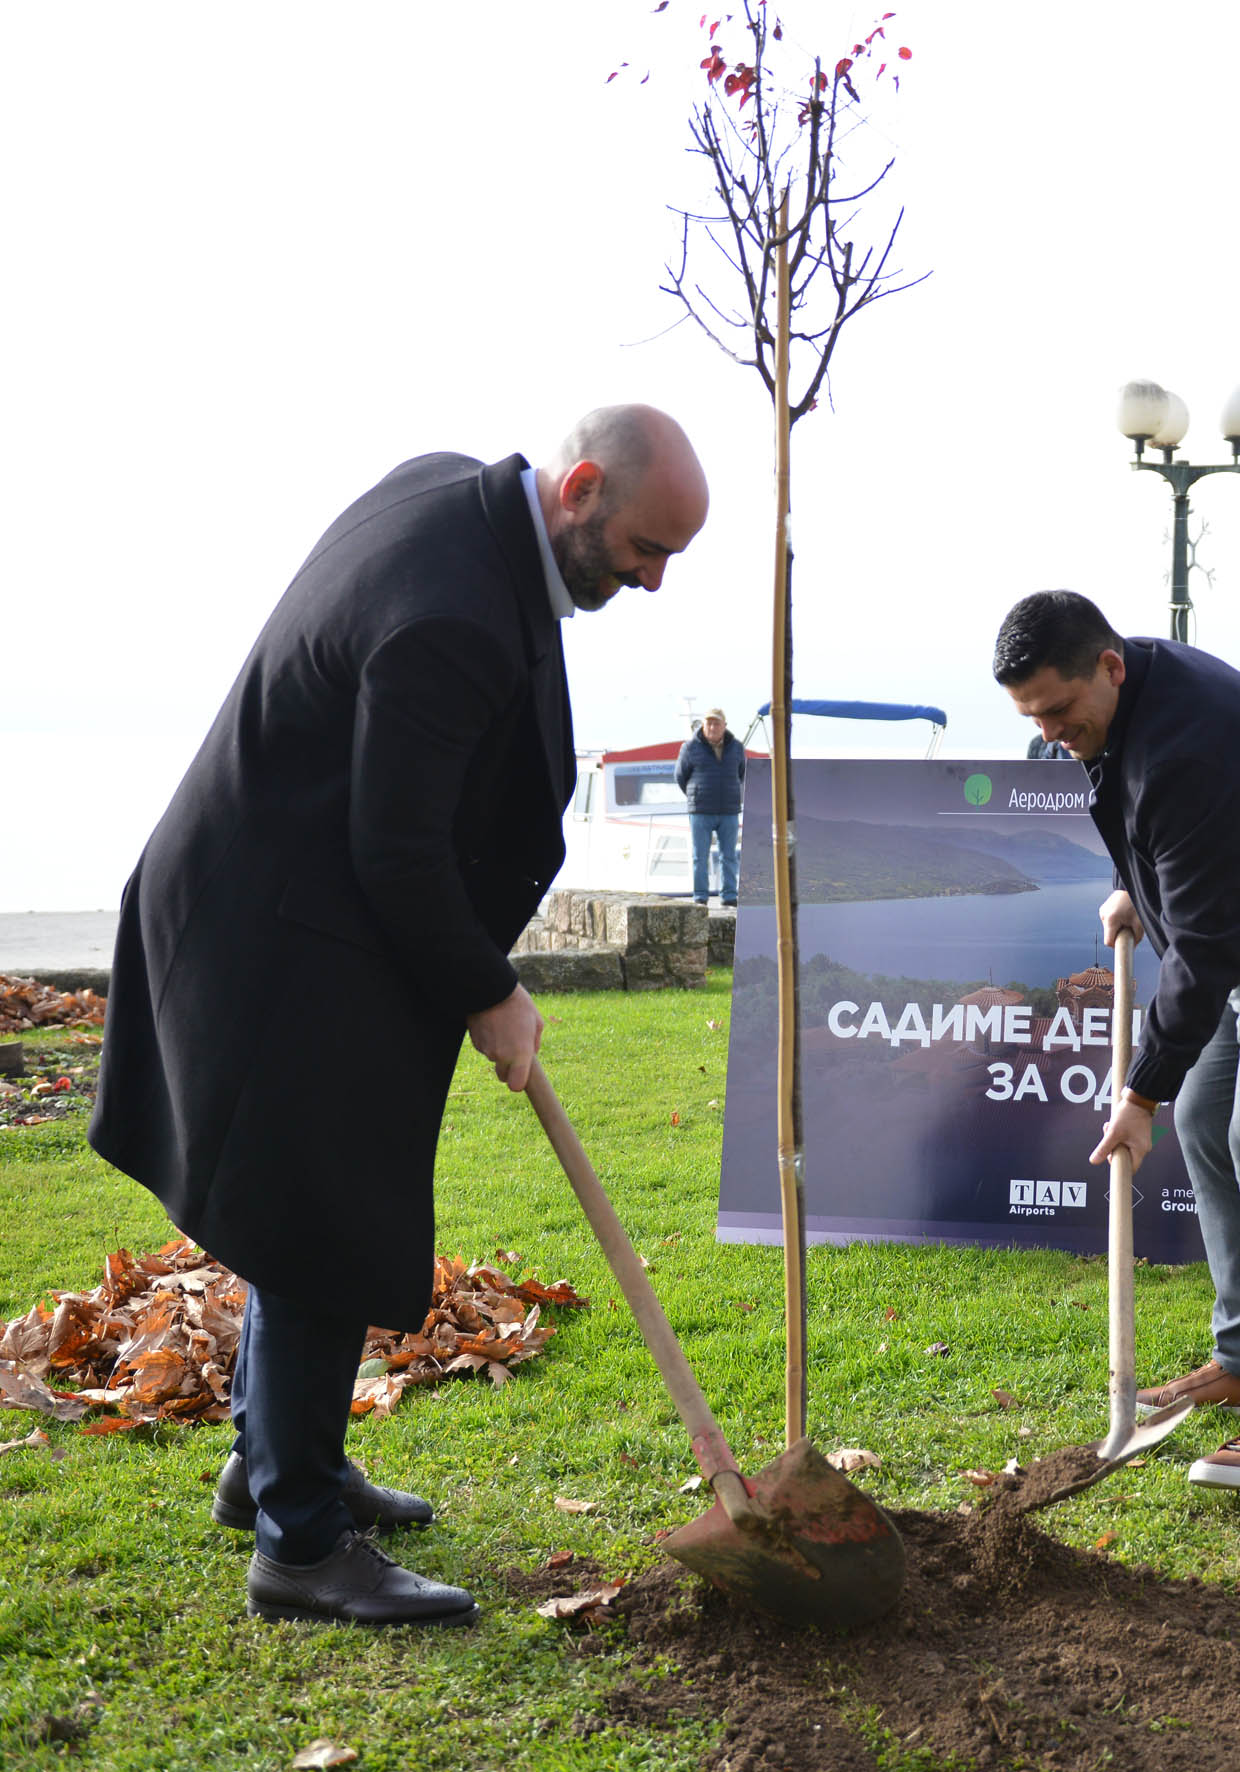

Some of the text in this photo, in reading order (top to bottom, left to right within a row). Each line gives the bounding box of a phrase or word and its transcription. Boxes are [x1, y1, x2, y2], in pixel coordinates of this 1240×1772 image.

[1008, 787, 1085, 811] Аеродром
[828, 1000, 1032, 1048] САДИМЕ
[986, 1062, 1049, 1102] ЗА
[1014, 1183, 1083, 1205] TAV
[1161, 1188, 1194, 1199] a me
[1009, 1205, 1056, 1216] Airports
